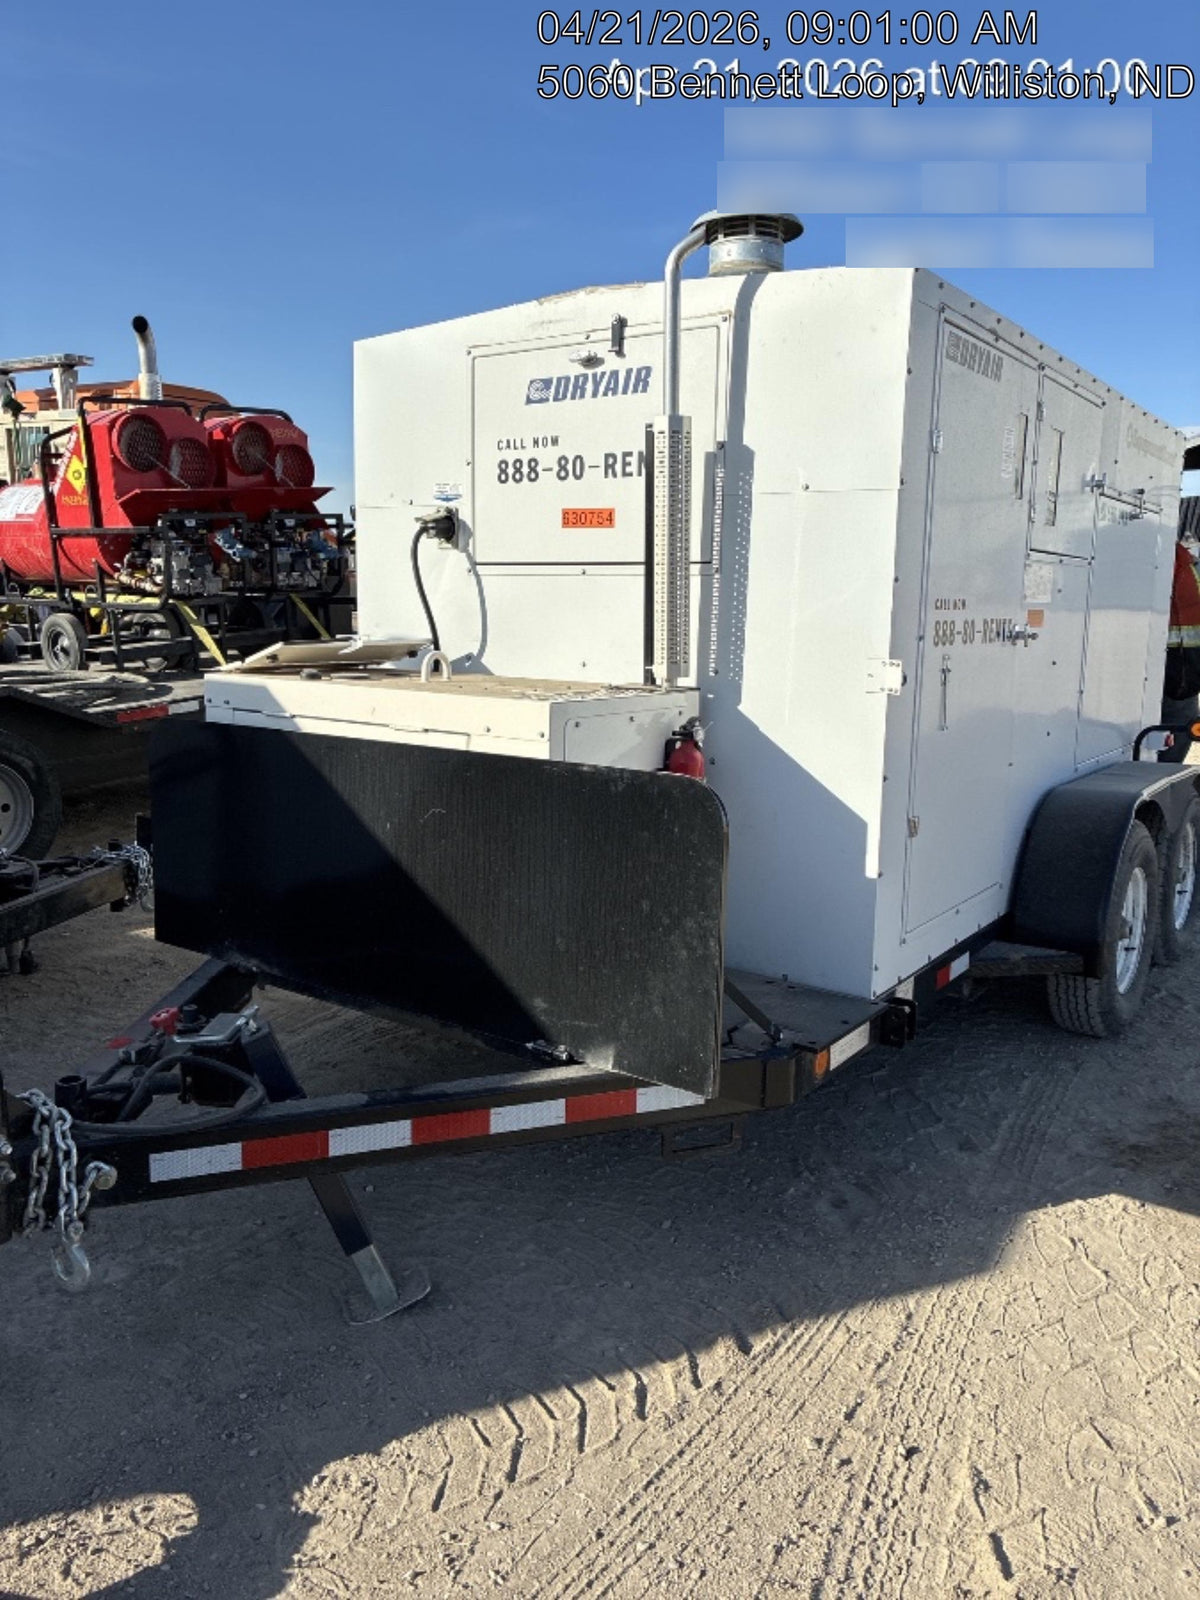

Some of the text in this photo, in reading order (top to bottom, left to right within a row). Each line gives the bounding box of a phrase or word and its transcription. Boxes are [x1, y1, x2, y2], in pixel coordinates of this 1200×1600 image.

[959, 337, 1004, 383] DRYAIR
[551, 366, 653, 402] DRYAIR
[497, 435, 560, 451] CALL NOW
[562, 511, 614, 526] 630754
